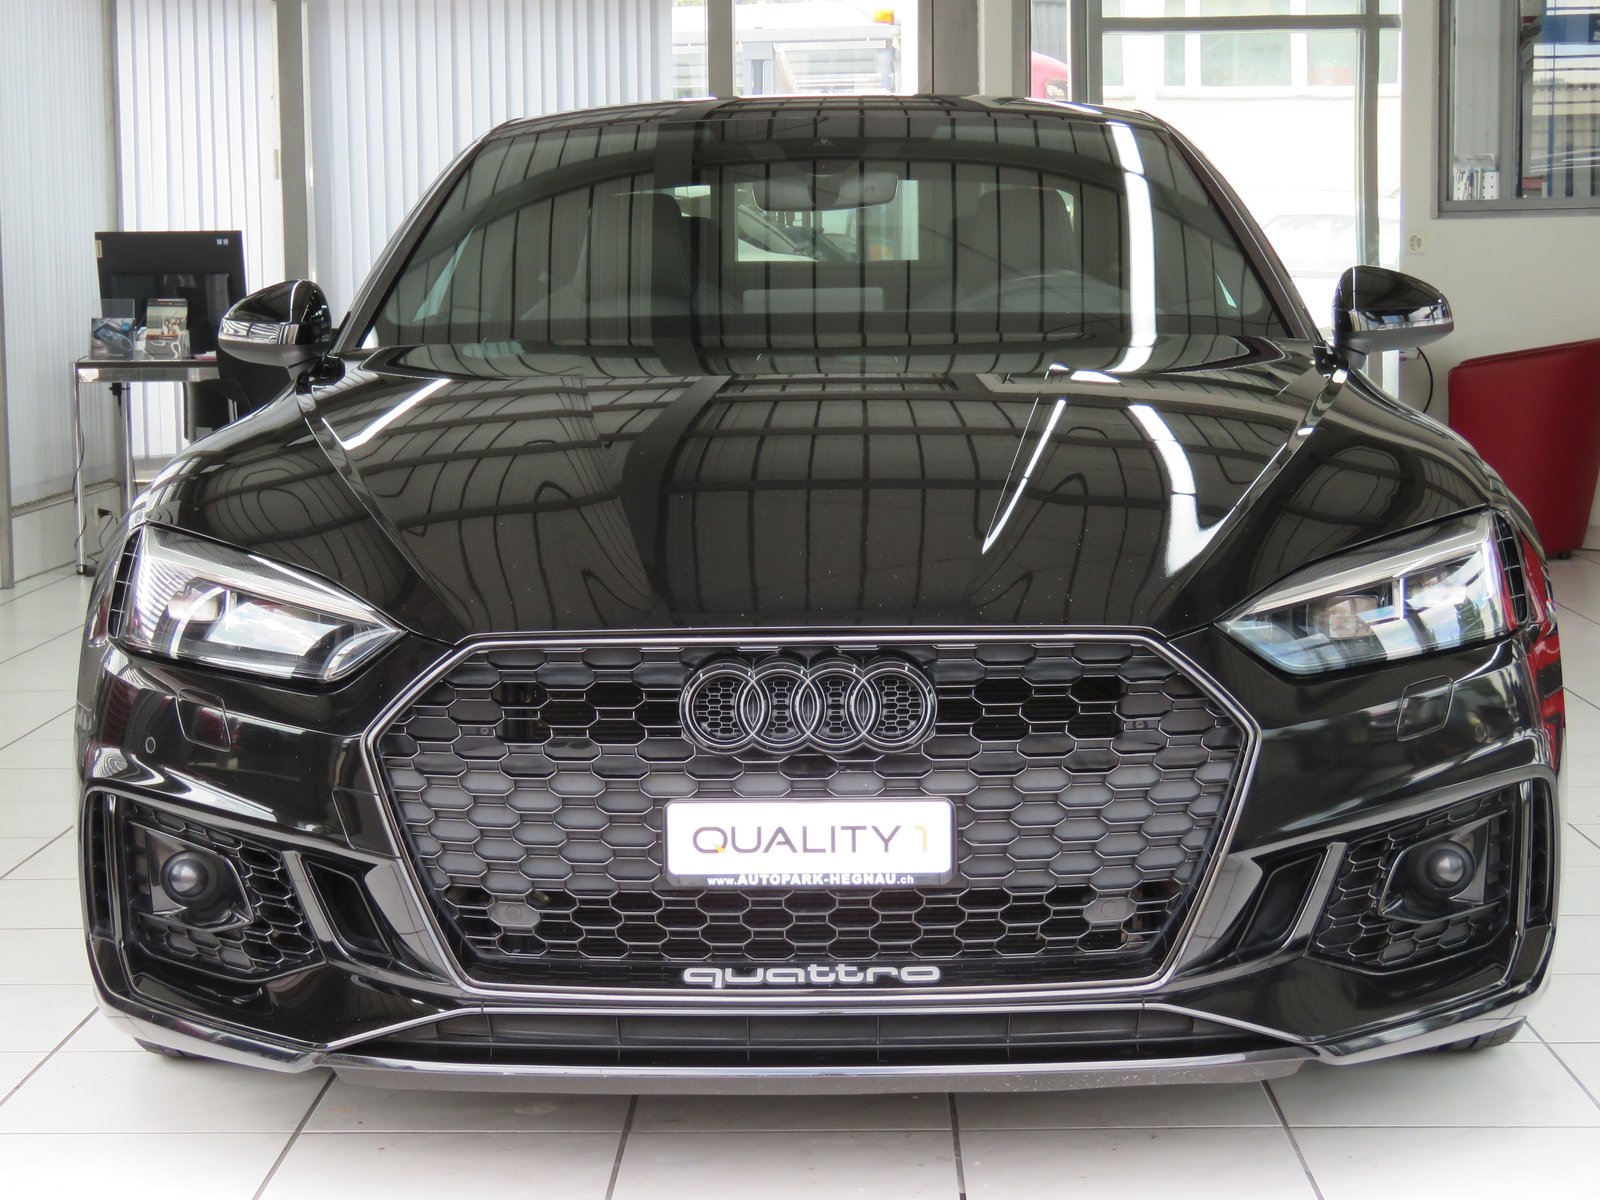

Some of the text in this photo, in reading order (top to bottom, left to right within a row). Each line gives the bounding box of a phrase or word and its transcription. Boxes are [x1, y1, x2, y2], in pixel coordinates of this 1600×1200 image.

[692, 825, 928, 853] QUALITY 1
[707, 873, 914, 885] www.AUTOPARK-HEGNAU.ch
[682, 963, 941, 988] quattro
